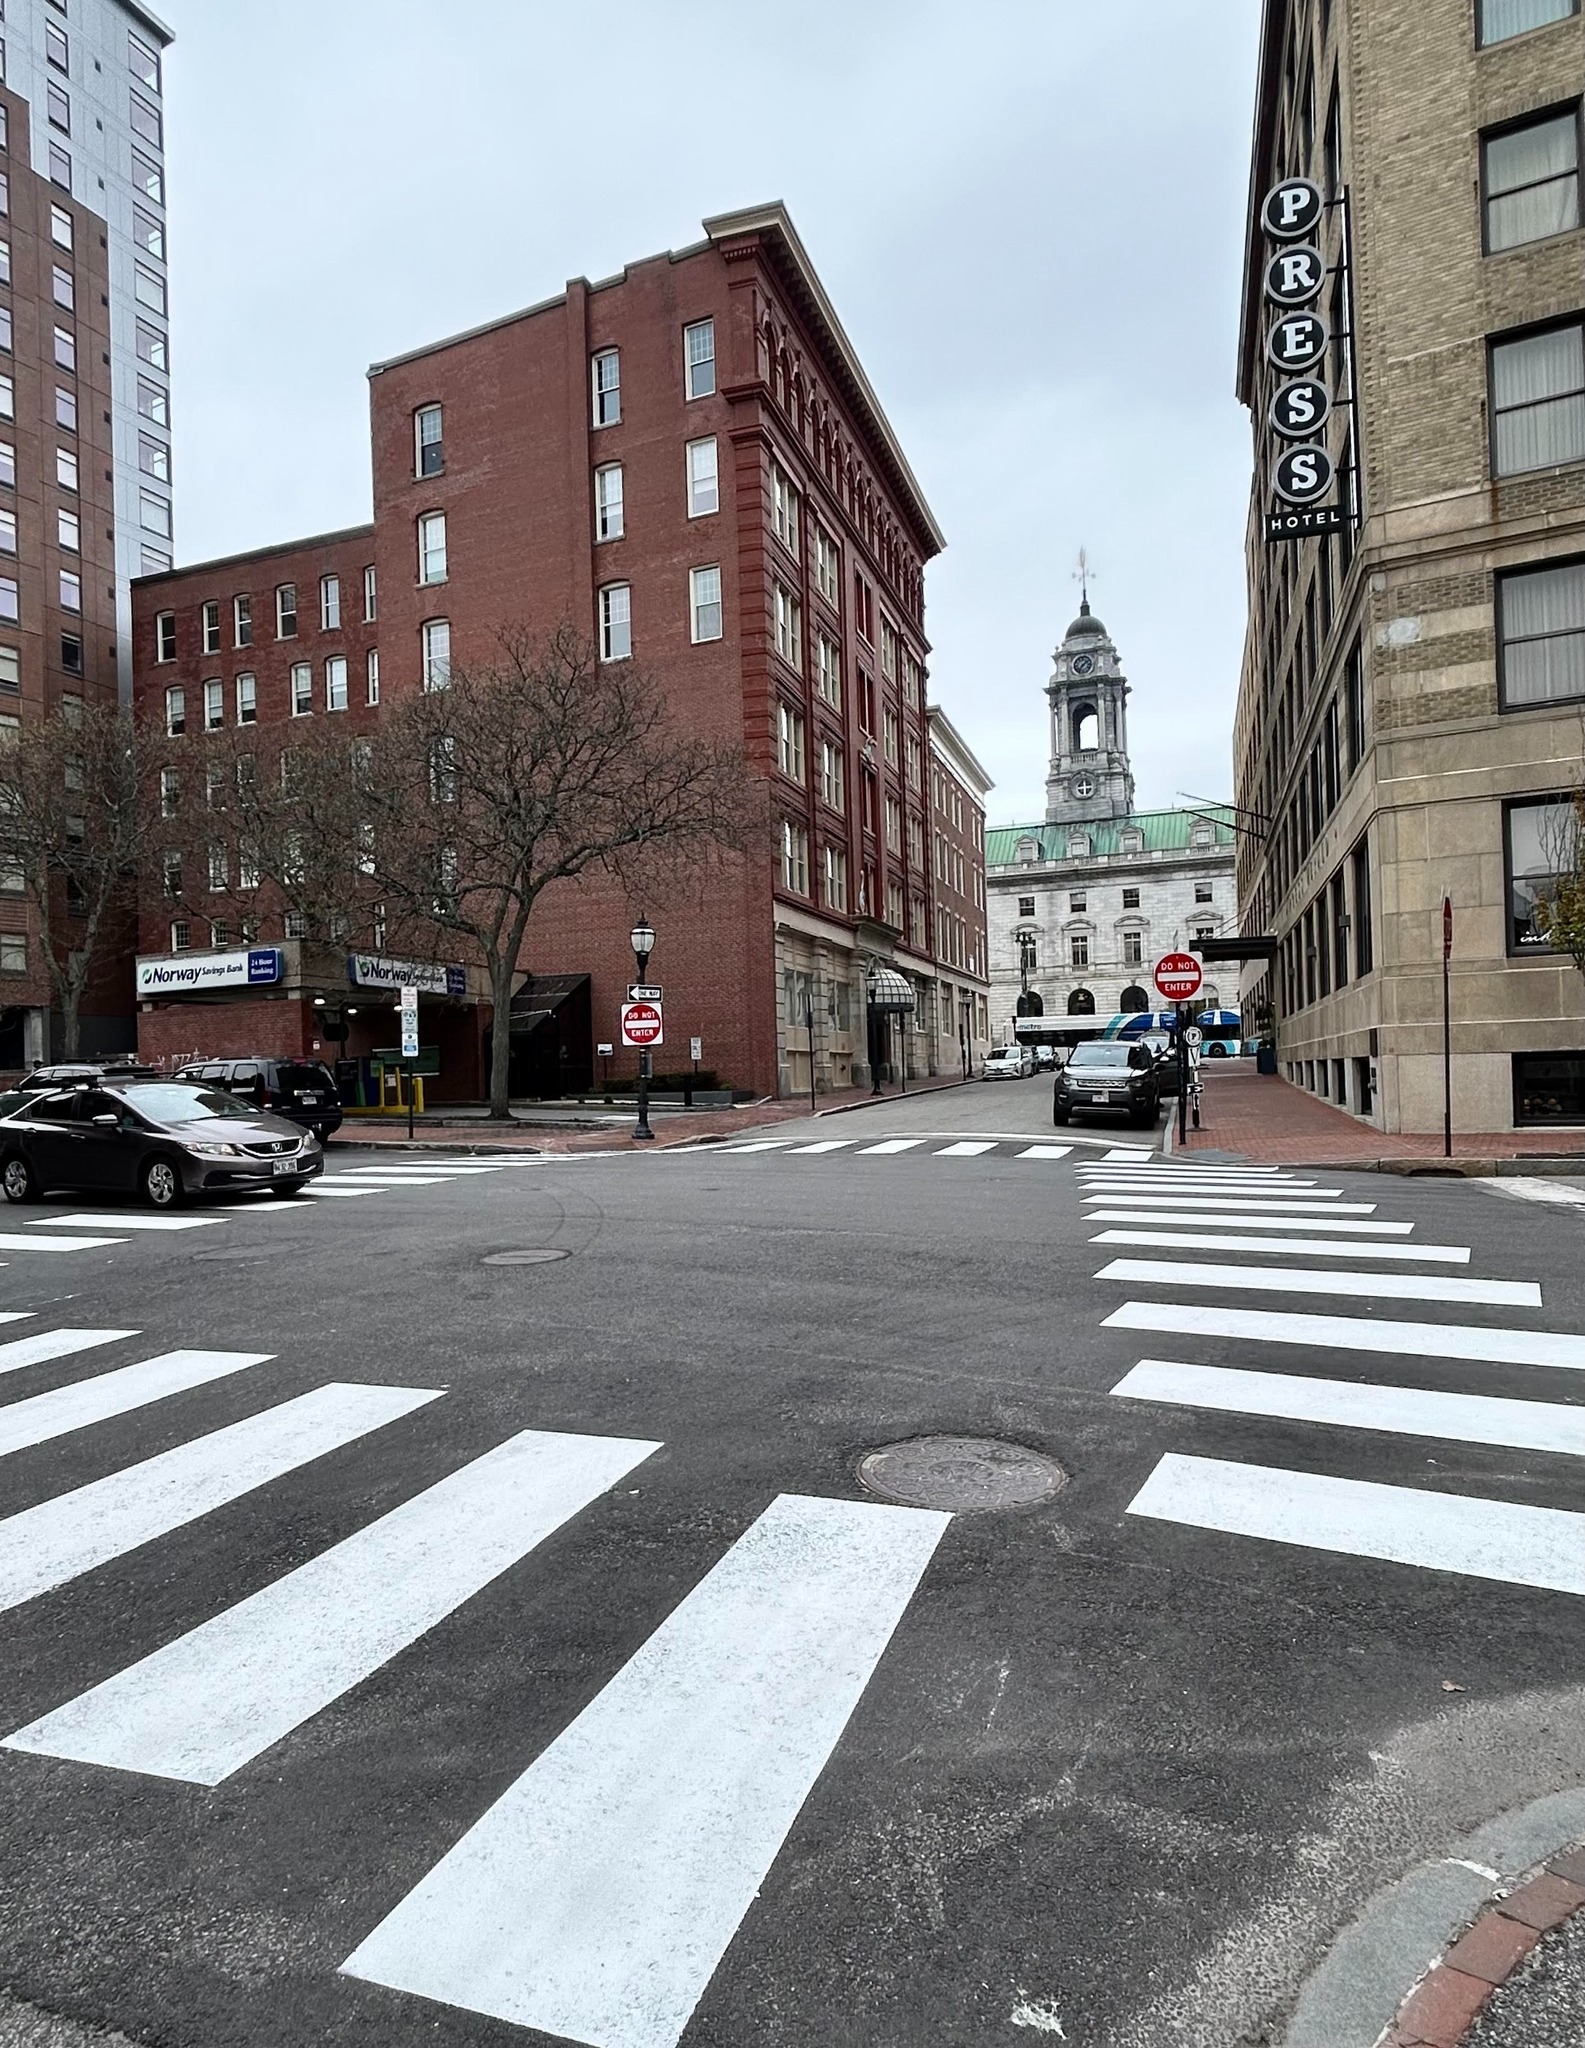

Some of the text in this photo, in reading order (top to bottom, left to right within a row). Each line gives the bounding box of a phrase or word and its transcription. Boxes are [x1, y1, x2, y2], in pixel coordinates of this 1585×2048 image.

[1278, 187, 1318, 491] PRESS
[1271, 511, 1340, 531] HOTEL
[370, 962, 412, 985] Norway
[1161, 961, 1195, 971] DO NOT
[153, 964, 243, 984] Norway Savings Bank
[1164, 983, 1192, 992] ENTER
[628, 1011, 656, 1020] DO NOT
[631, 1029, 654, 1037] ENTER
